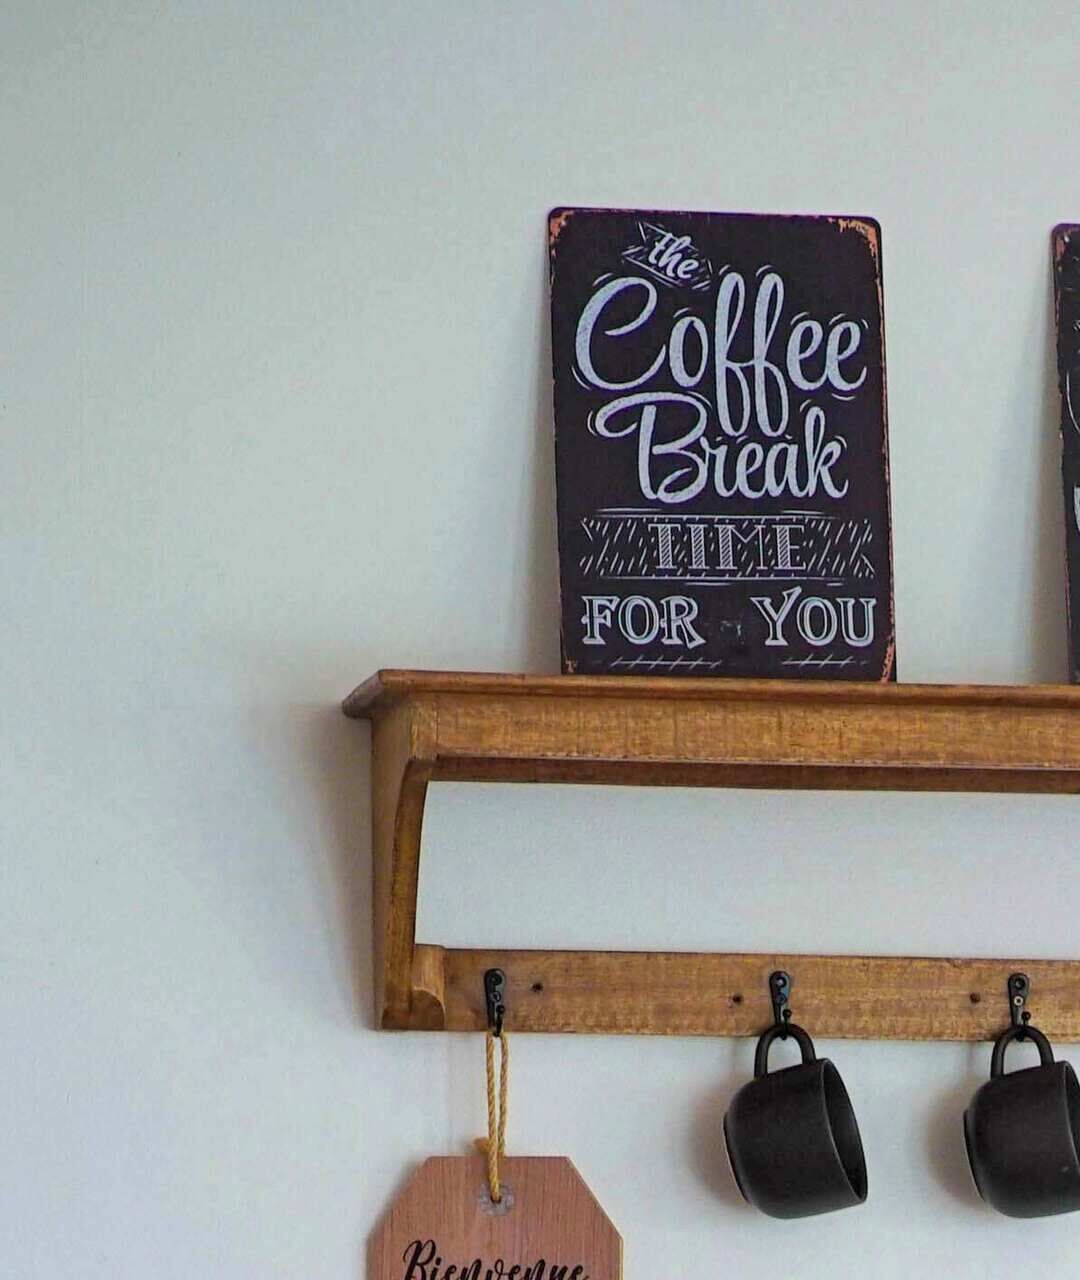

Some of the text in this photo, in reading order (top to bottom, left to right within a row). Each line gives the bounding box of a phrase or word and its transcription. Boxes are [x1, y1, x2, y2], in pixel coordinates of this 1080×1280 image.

[648, 232, 699, 280] the
[575, 272, 868, 437] Coffee
[595, 391, 849, 503] Break
[649, 524, 806, 570] TIME
[582, 586, 877, 648] FOR YOU
